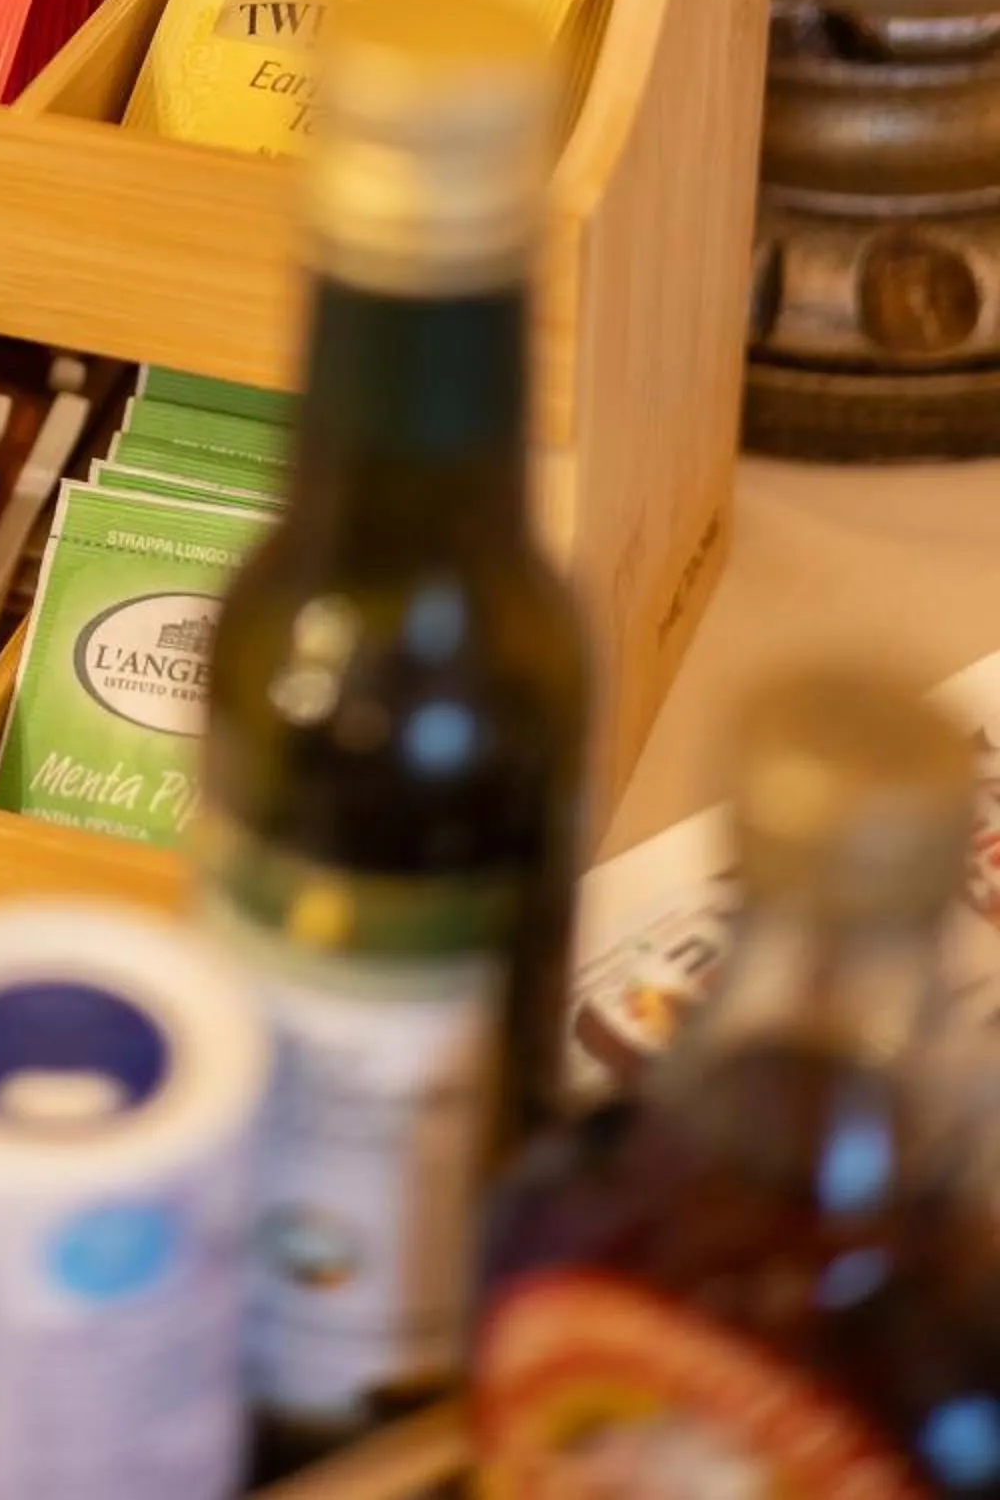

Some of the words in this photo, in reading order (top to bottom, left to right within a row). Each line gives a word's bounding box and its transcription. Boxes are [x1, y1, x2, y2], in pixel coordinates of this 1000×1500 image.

[249, 60, 315, 98] Ear
[94, 644, 215, 687] L'ANGE
[28, 752, 145, 811] Menta
